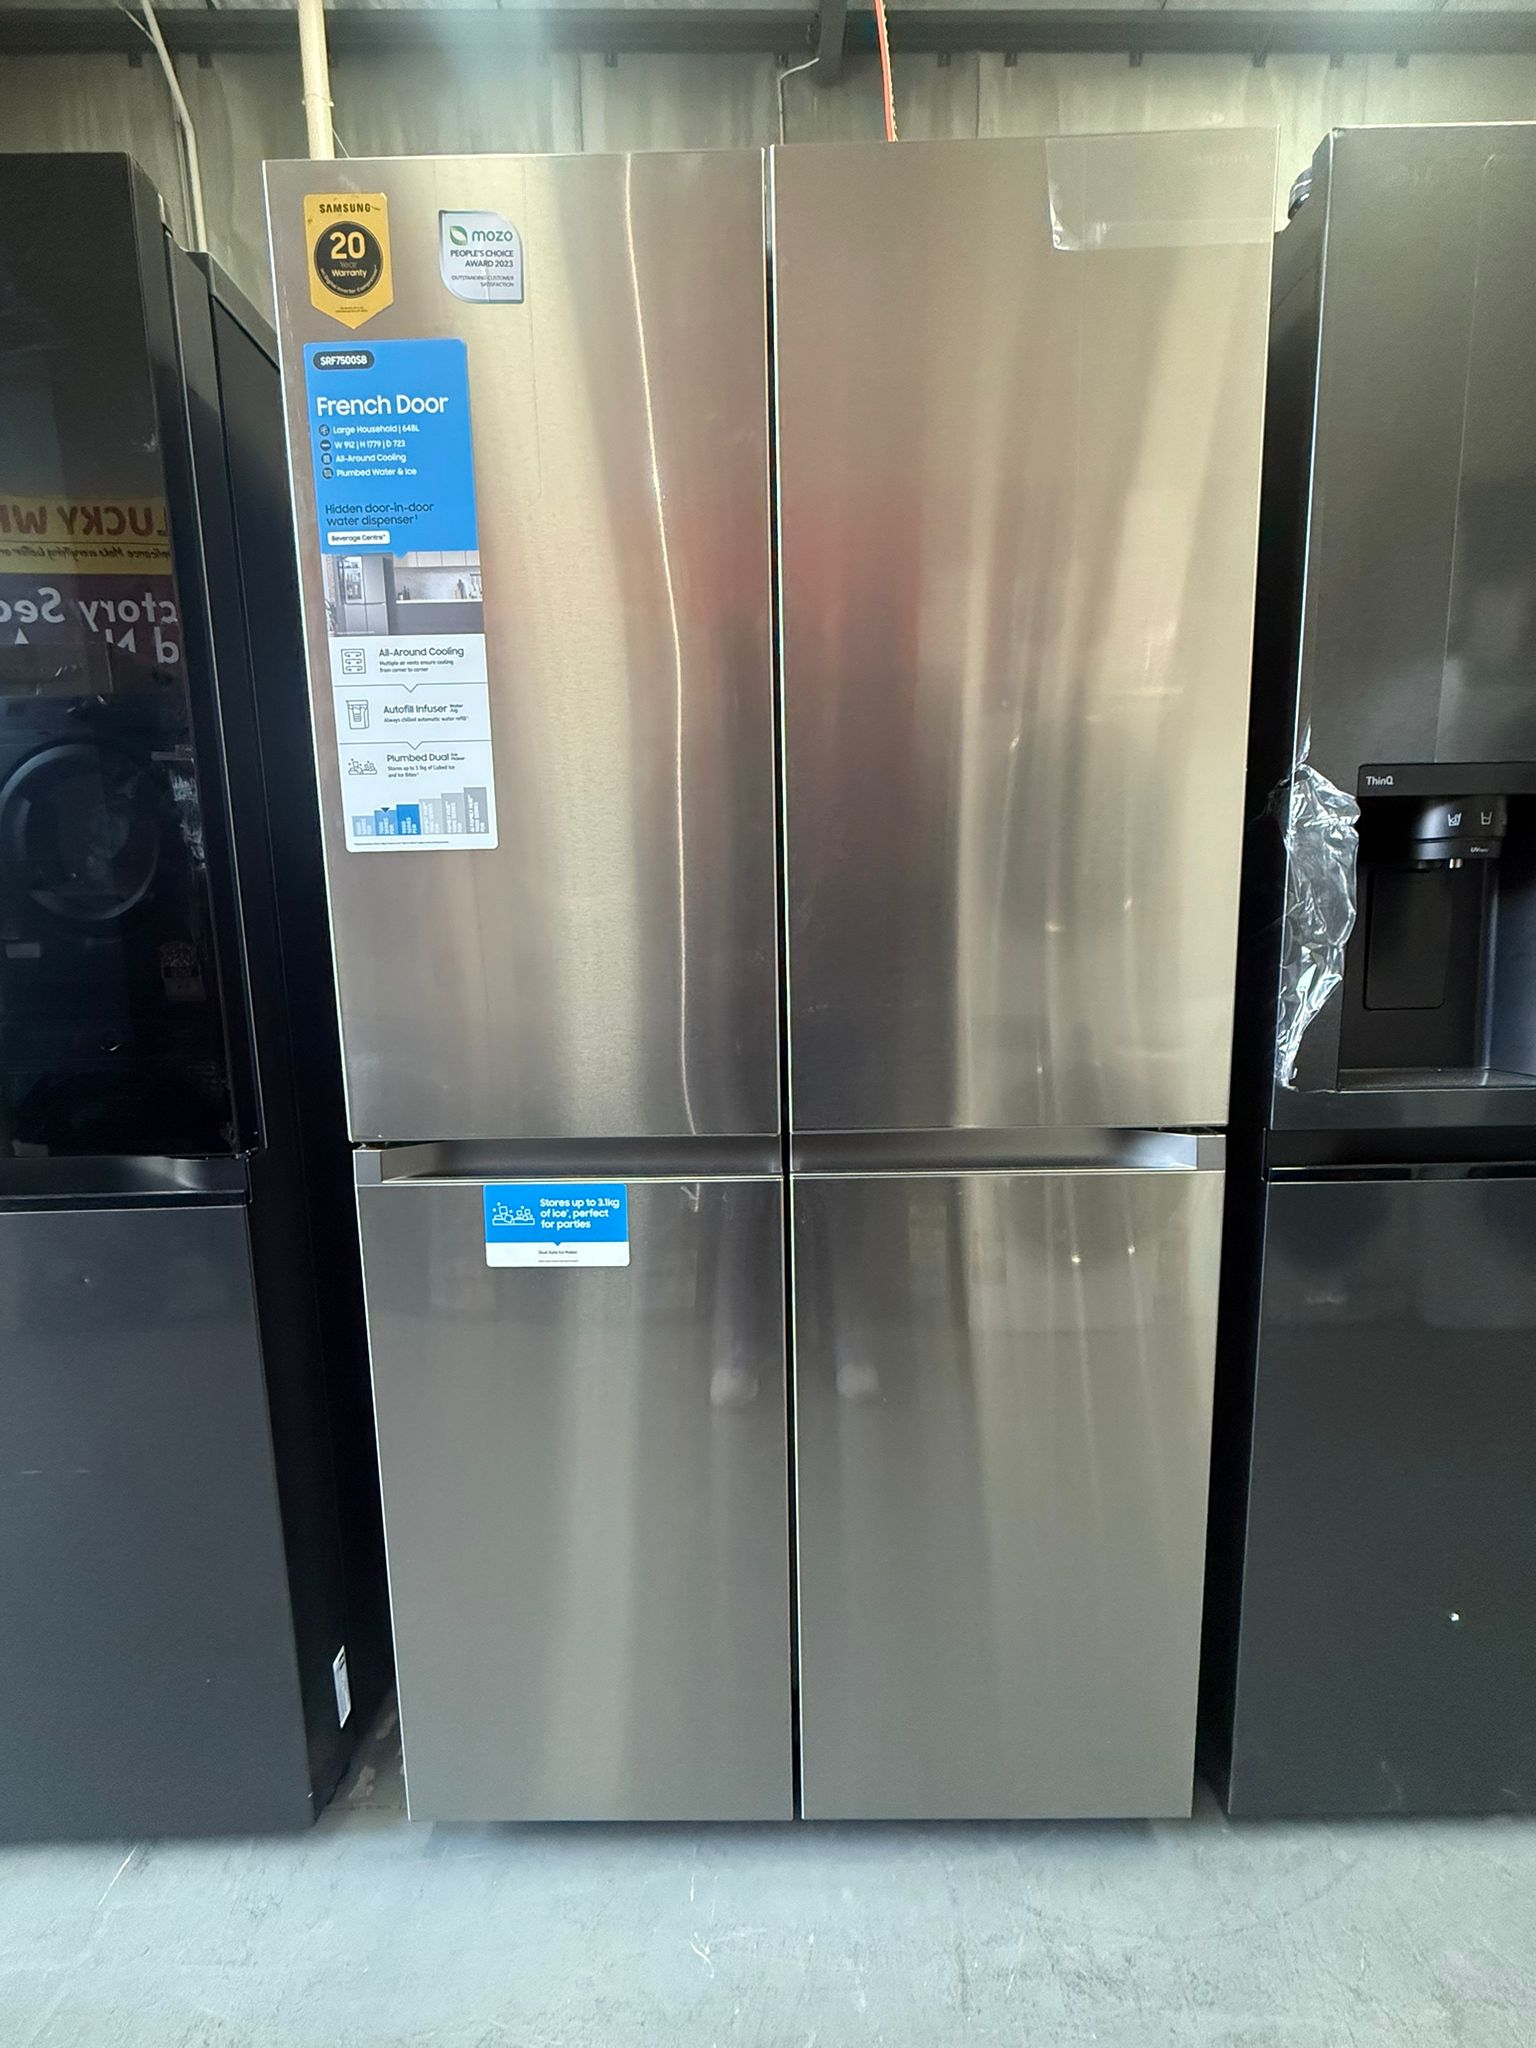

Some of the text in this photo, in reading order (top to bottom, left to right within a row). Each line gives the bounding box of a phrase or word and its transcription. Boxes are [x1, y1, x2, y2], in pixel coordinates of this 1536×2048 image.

[319, 202, 371, 213] SAMSUNG
[471, 230, 513, 243] mozo
[329, 231, 366, 260] 20
[450, 250, 514, 258] PEOPLE'S CHOICE
[465, 260, 514, 268] AWARD 2023
[331, 268, 367, 279] Warranty
[320, 354, 368, 366] SRF7500SB
[316, 393, 449, 417] French Door
[333, 426, 356, 436] Large
[356, 424, 398, 434] Household
[402, 424, 420, 433] 648L
[334, 441, 343, 449] W
[344, 440, 356, 449] 912
[359, 440, 367, 448] H
[367, 440, 382, 448] 1779
[393, 439, 406, 448] 723
[335, 453, 407, 463] All-Around Cooling
[336, 467, 417, 477] Plumbed Water & Ice
[325, 501, 435, 514] Hidden door-in-door
[326, 517, 360, 526] water
[331, 534, 362, 542] Beverage
[379, 646, 465, 658] All-Around Cooling
[383, 703, 448, 714] Autofill Infuser
[386, 752, 450, 763] Plumbed Dual
[1365, 775, 1394, 786] ThinQ
[539, 1197, 620, 1209] Stores up to 3.1kg
[540, 1208, 551, 1218] of
[572, 1208, 609, 1220] perfect
[540, 1219, 592, 1231] for parties
